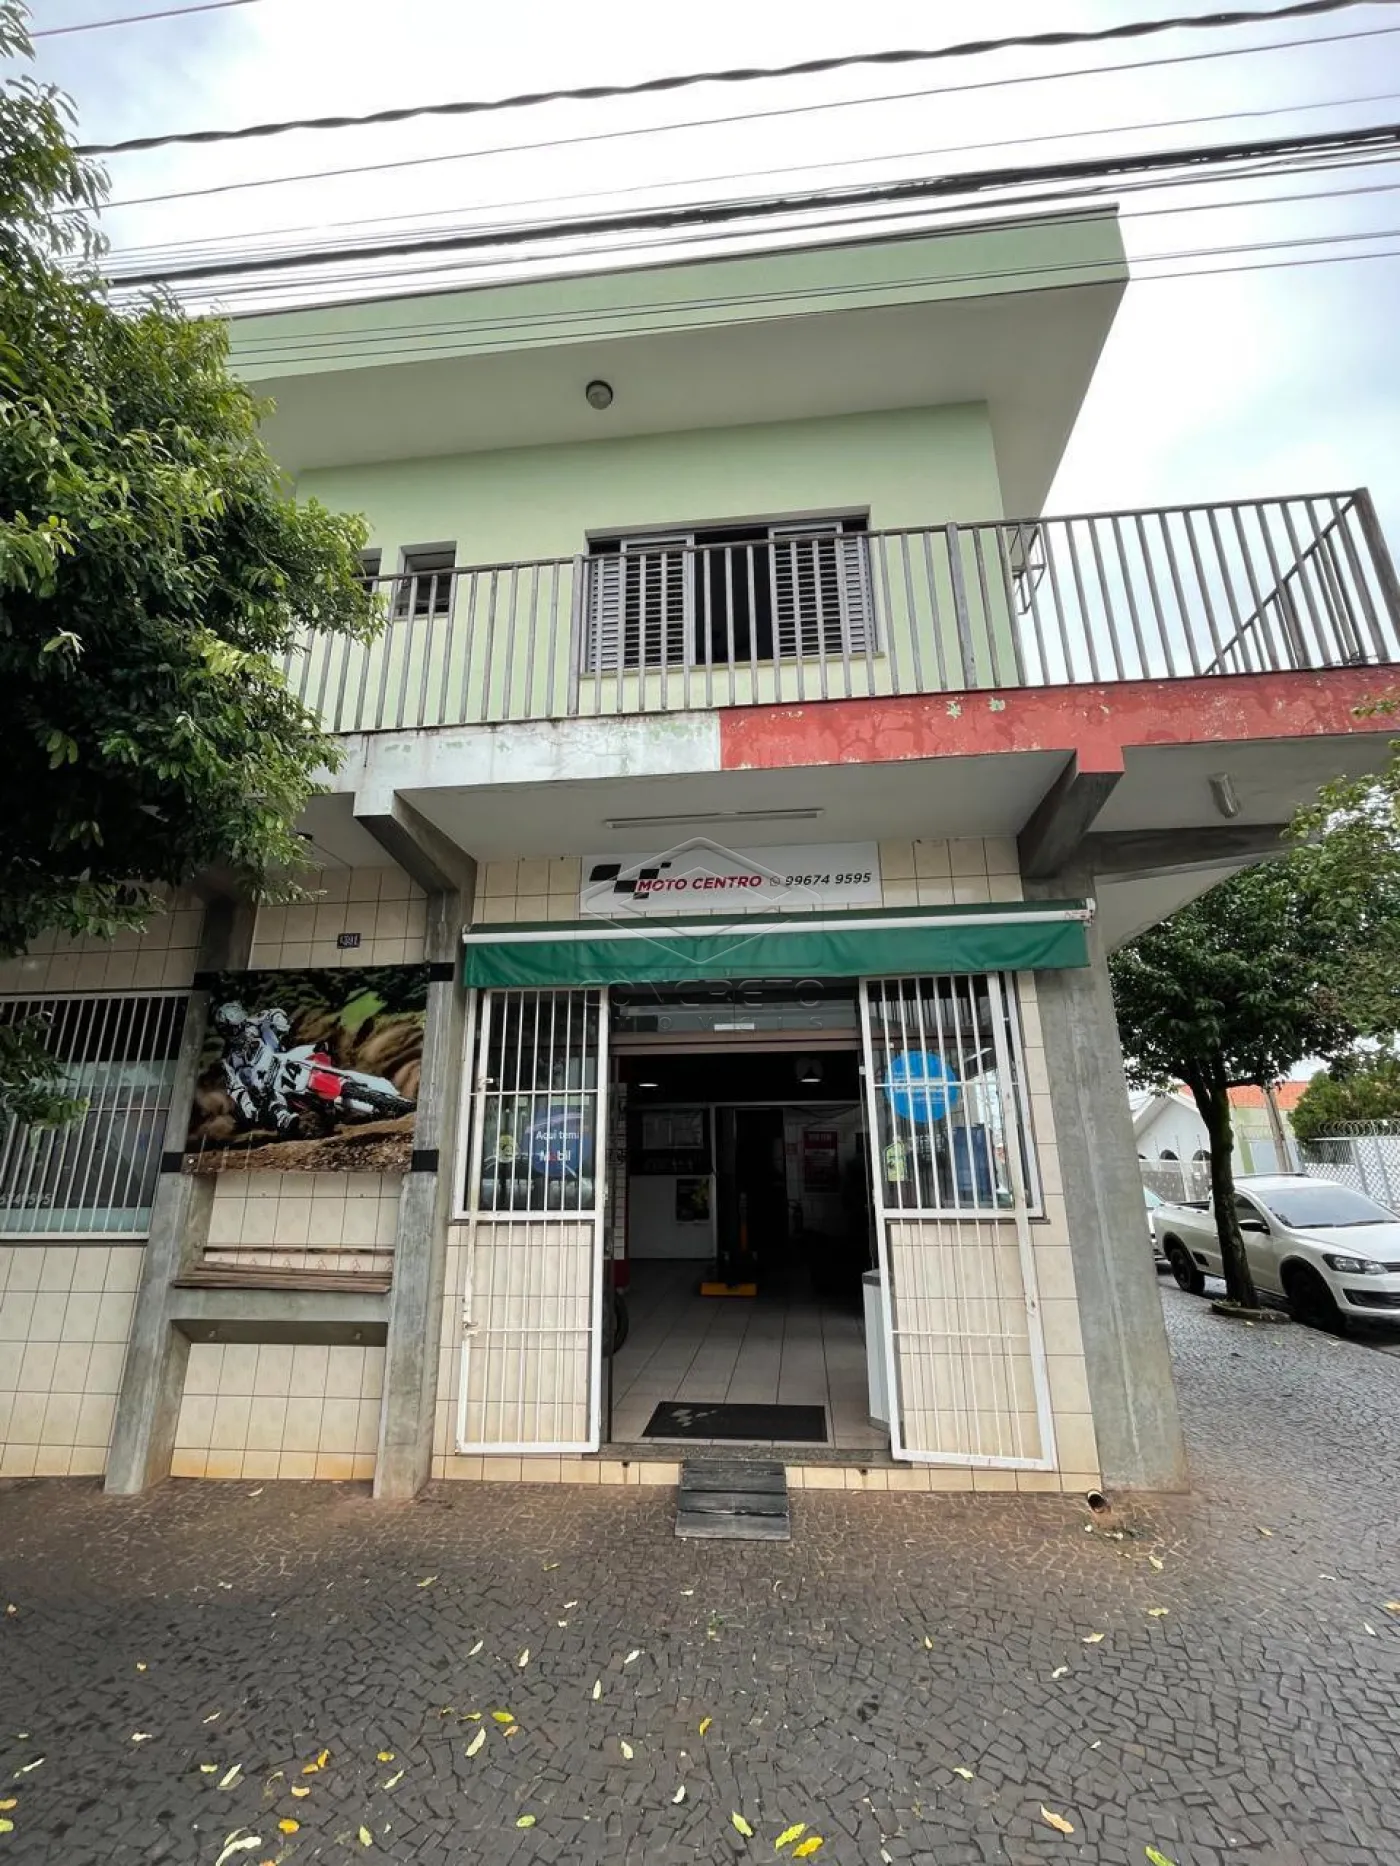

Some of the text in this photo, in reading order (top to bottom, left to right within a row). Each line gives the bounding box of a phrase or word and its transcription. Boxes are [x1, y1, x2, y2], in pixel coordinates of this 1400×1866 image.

[638, 872, 872, 892] MOTO CENTRO 99674 9595
[281, 1060, 302, 1091] 14
